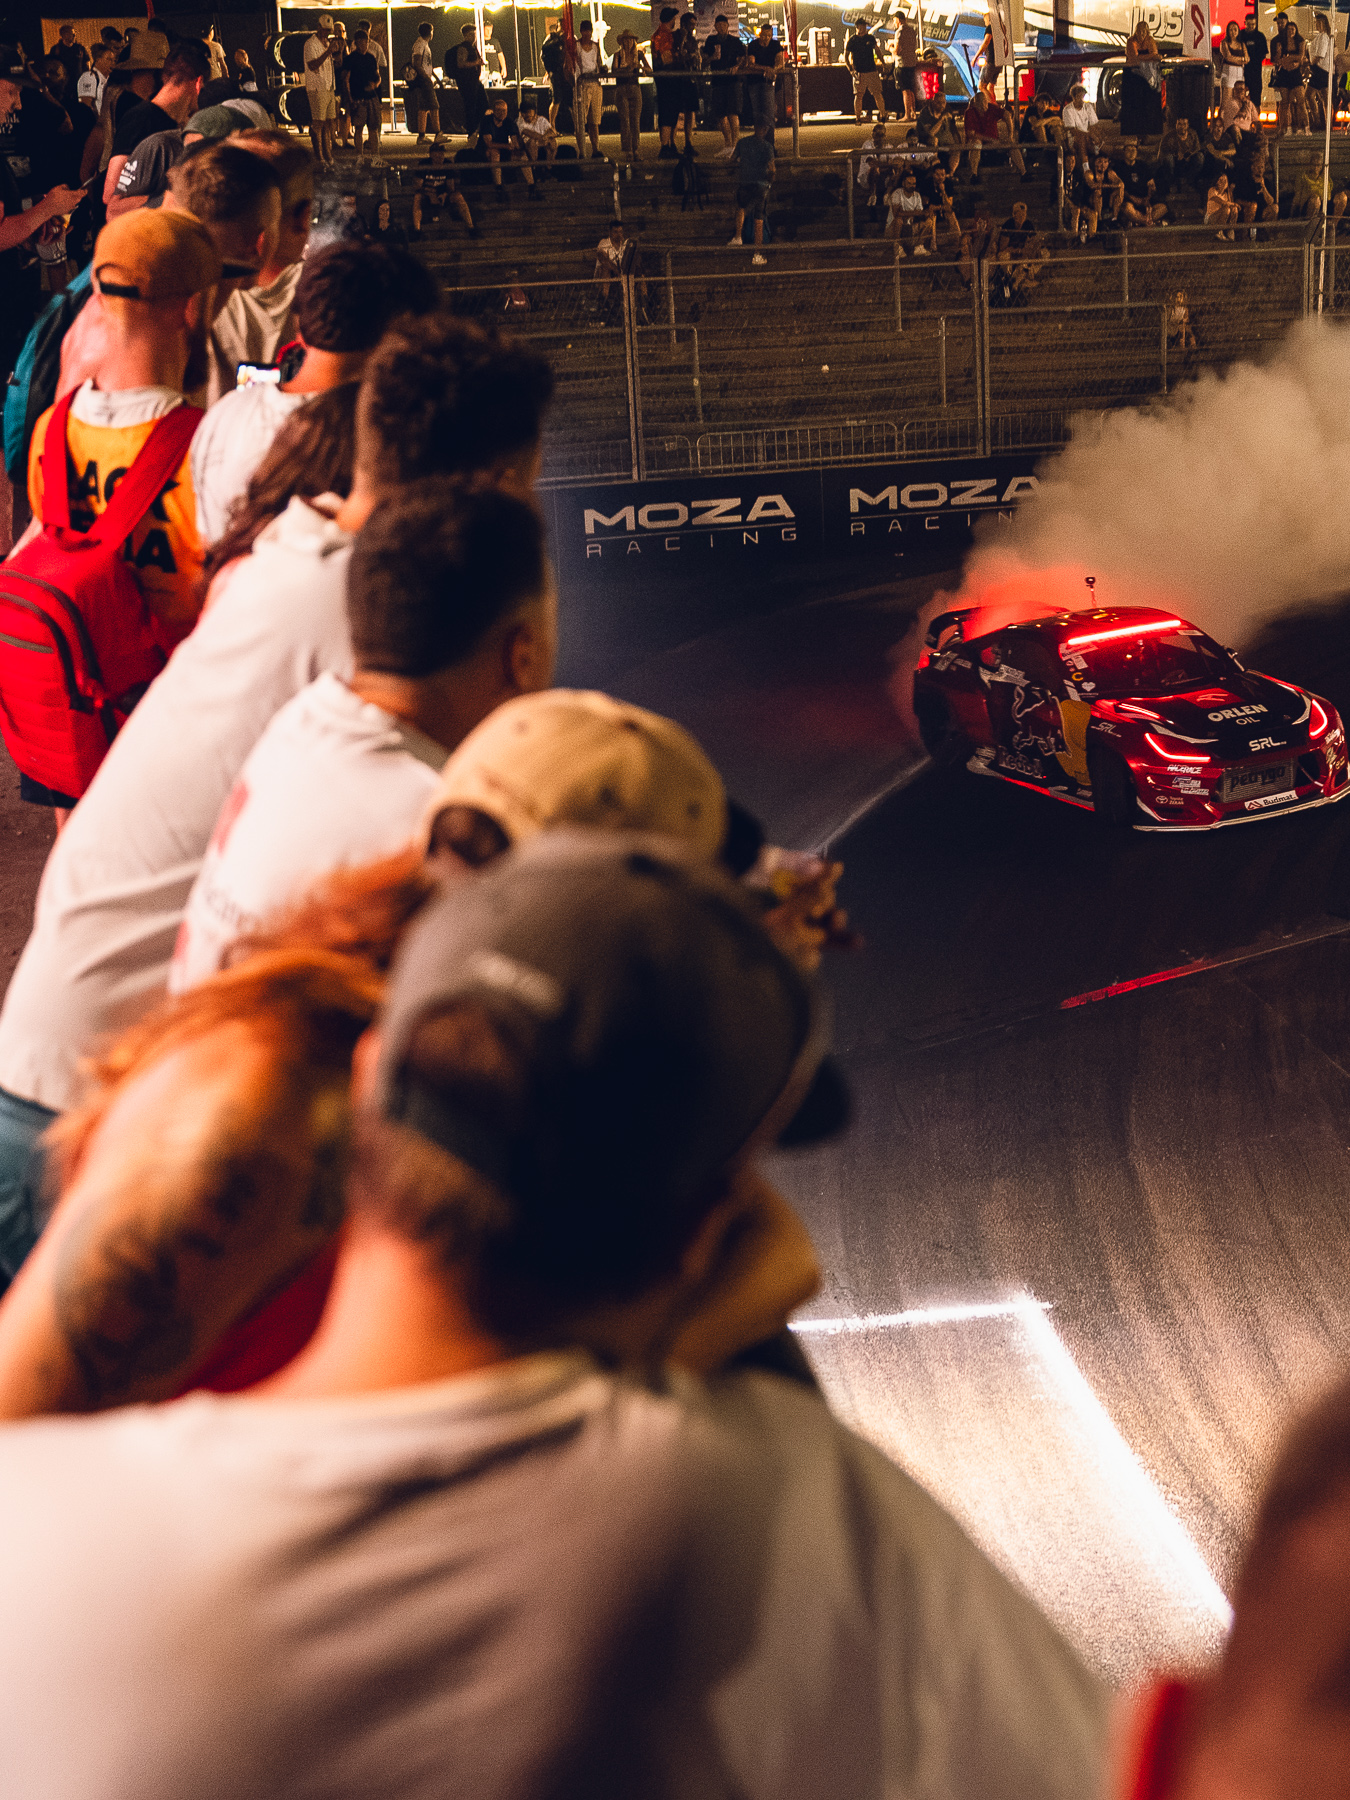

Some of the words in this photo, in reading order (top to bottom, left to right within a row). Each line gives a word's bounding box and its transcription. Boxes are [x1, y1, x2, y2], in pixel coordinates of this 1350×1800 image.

[850, 476, 1042, 513] MOZA
[584, 494, 795, 535] MOZA
[851, 511, 1013, 536] RACIN
[587, 527, 796, 558] RACING
[1207, 704, 1268, 722] ORLEN
[1235, 717, 1260, 725] OIL
[1249, 736, 1281, 751] SRL
[1263, 794, 1293, 805] Budmat
